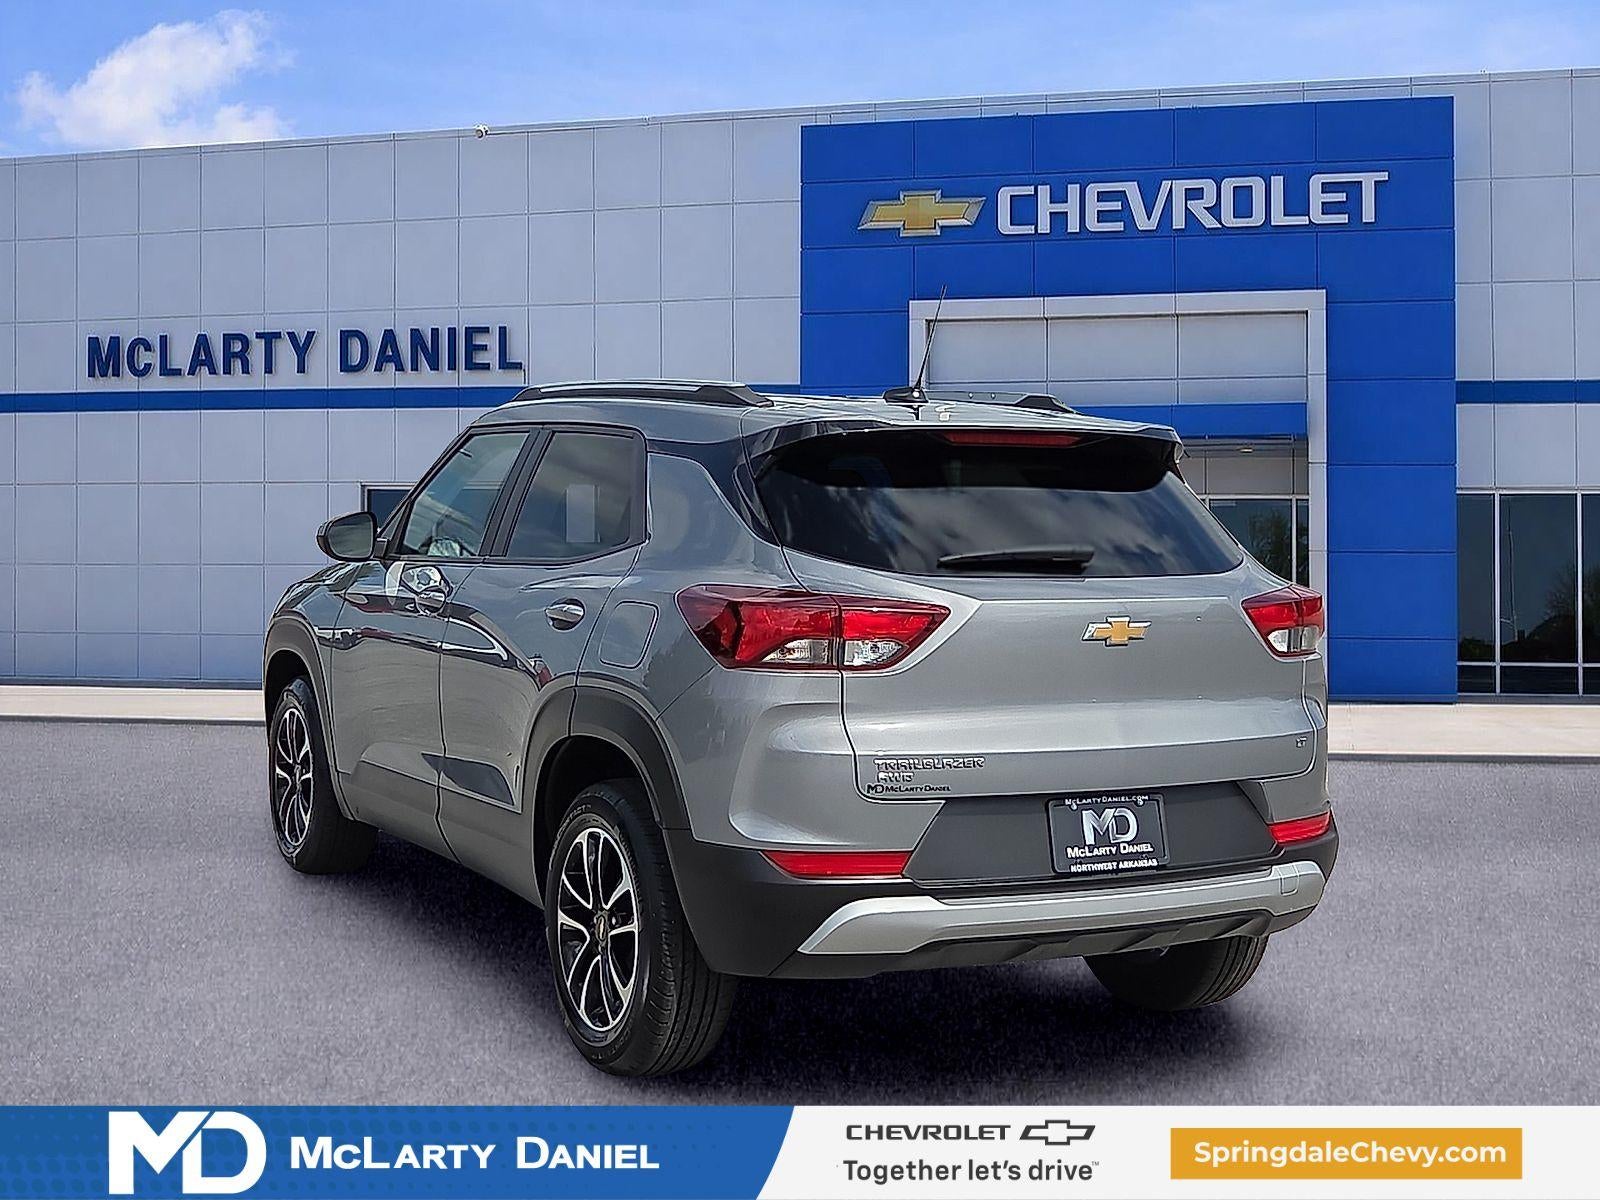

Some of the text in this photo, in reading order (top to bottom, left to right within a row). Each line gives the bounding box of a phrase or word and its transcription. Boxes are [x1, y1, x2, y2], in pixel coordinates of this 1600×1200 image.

[997, 170, 1389, 236] CHEVROLET
[339, 326, 524, 373] DANIEL
[1081, 807, 1138, 845] MD
[1070, 858, 1158, 873] NORTHWEST ARKANSAS
